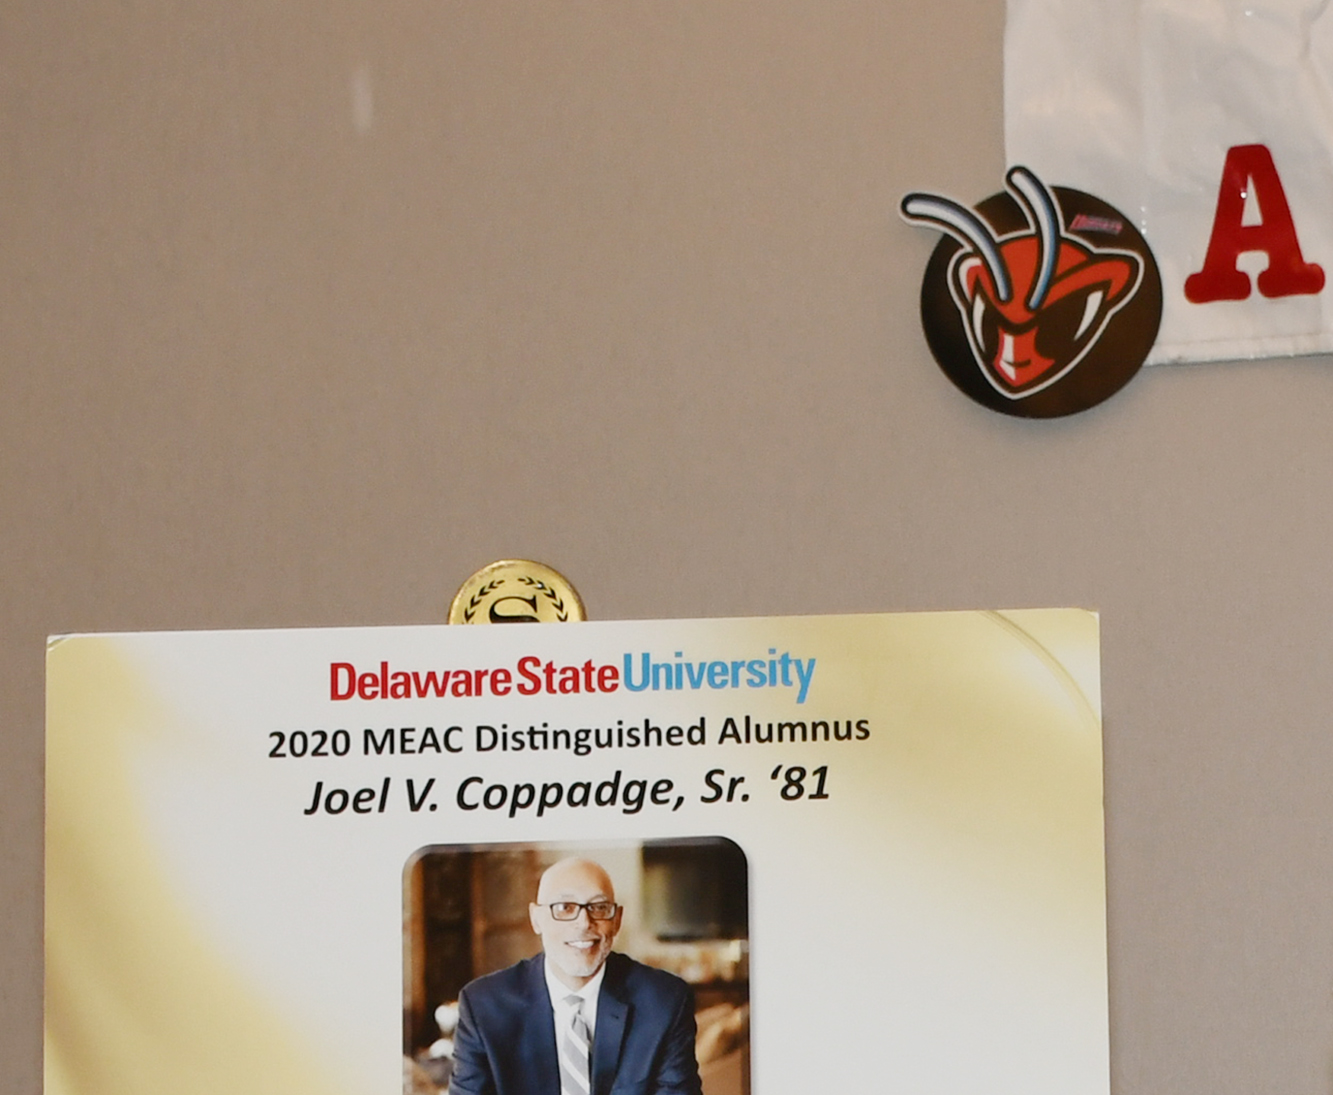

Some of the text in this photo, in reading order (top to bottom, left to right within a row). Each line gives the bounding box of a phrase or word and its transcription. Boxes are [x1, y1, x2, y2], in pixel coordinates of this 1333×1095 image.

[268, 715, 871, 758] 2020 MEAC Distinguished Alumnus
[303, 777, 391, 815] Joel
[405, 777, 438, 812] V.
[456, 770, 685, 818] Coppadge,
[700, 768, 750, 804] Sr.
